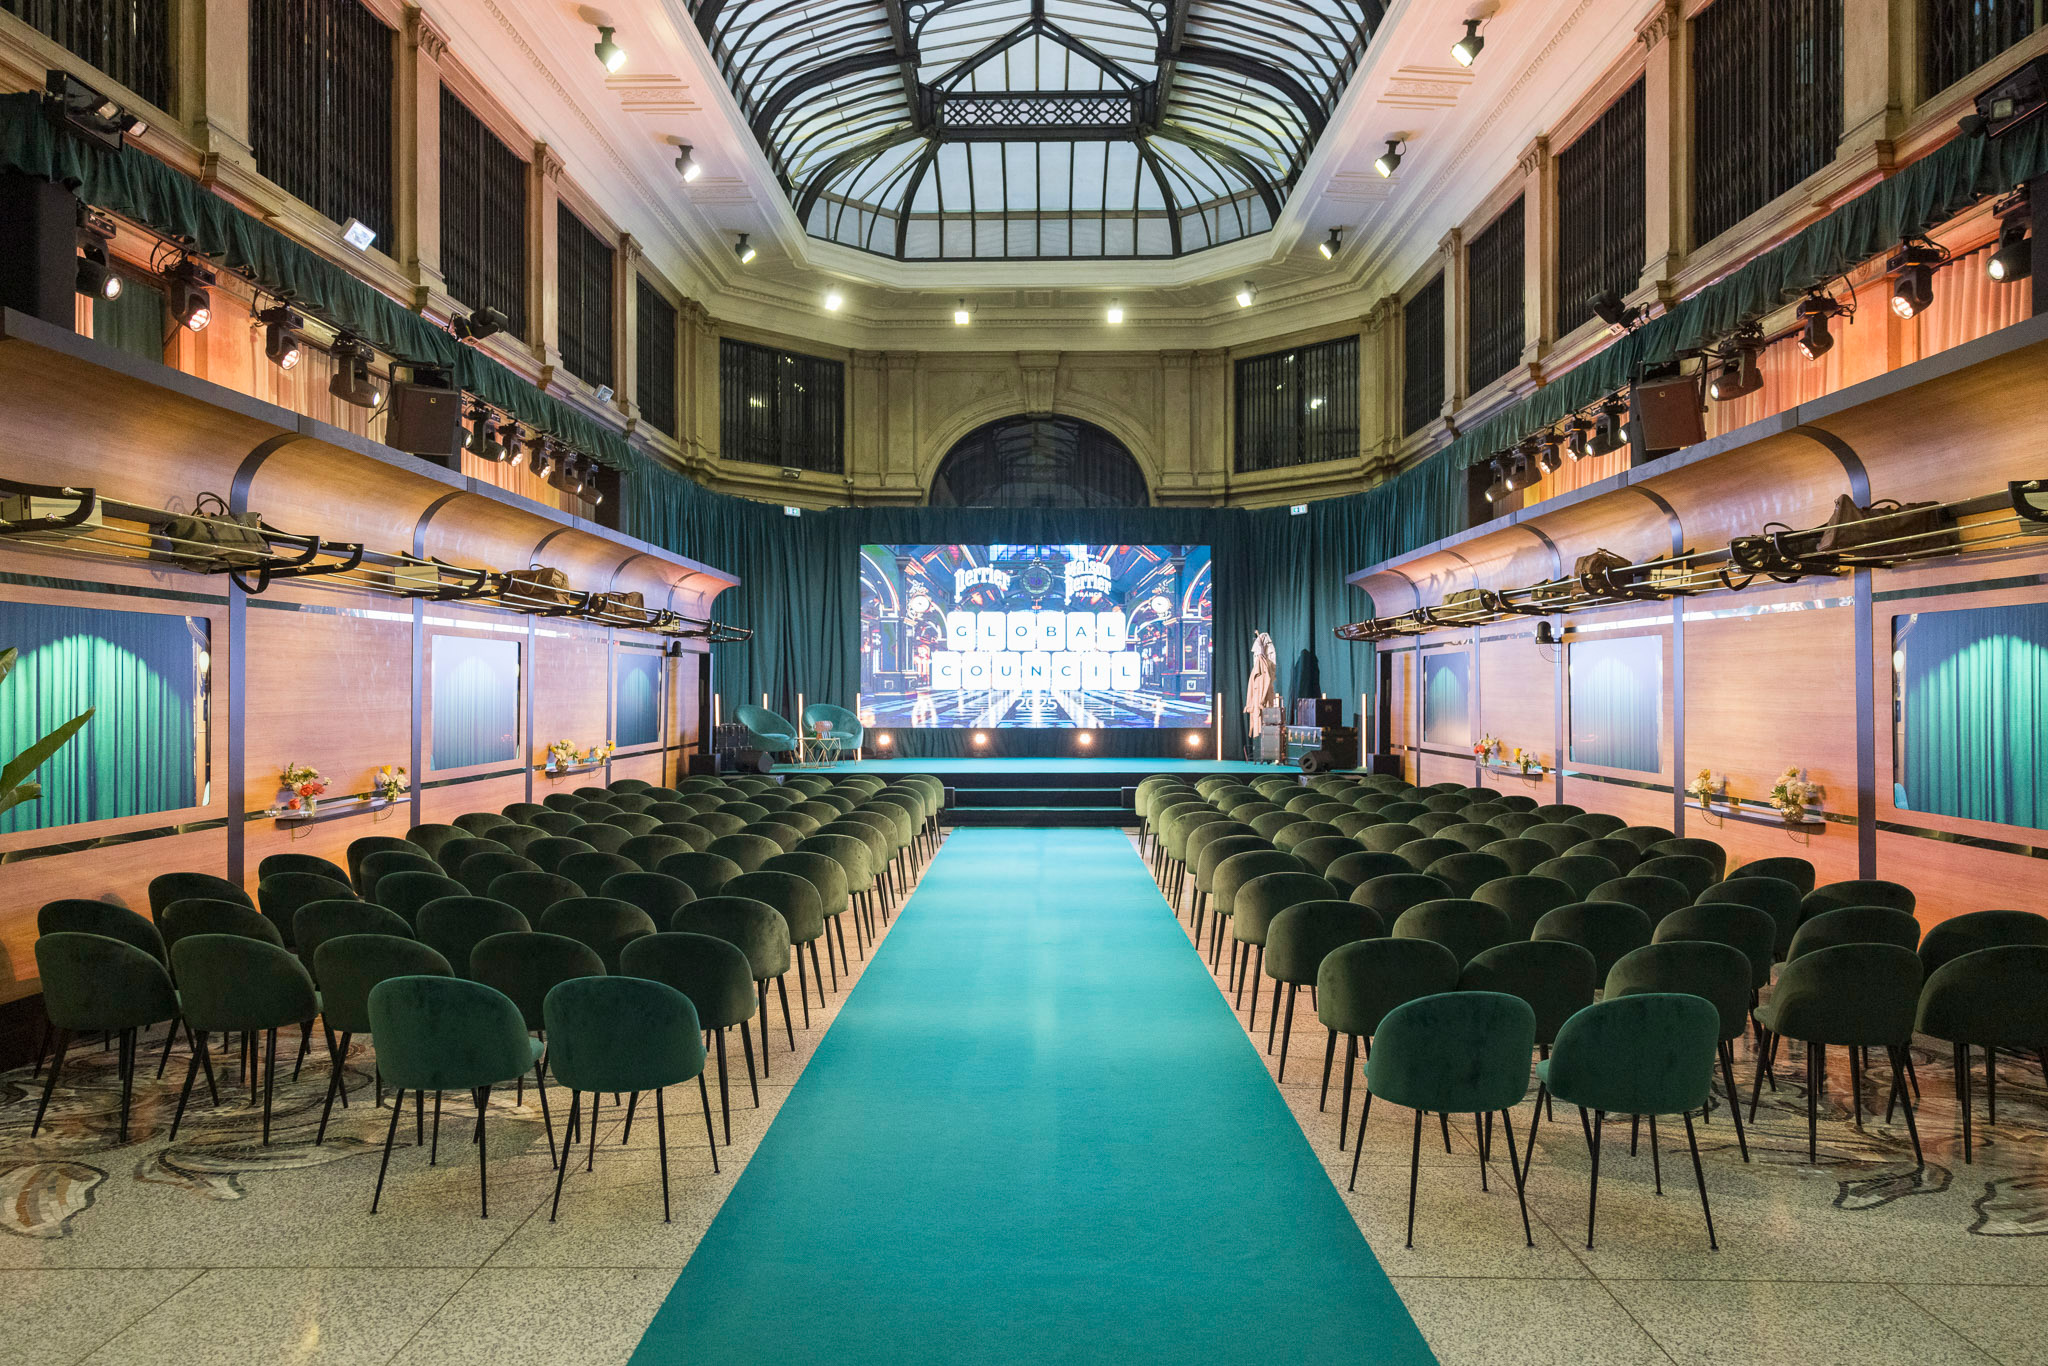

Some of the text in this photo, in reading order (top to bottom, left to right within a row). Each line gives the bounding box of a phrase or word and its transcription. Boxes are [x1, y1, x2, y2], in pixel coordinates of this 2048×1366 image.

[955, 625, 1116, 637] GLOBAL
[940, 665, 1131, 677] COUNCIL
[1015, 697, 1058, 711] 2025
